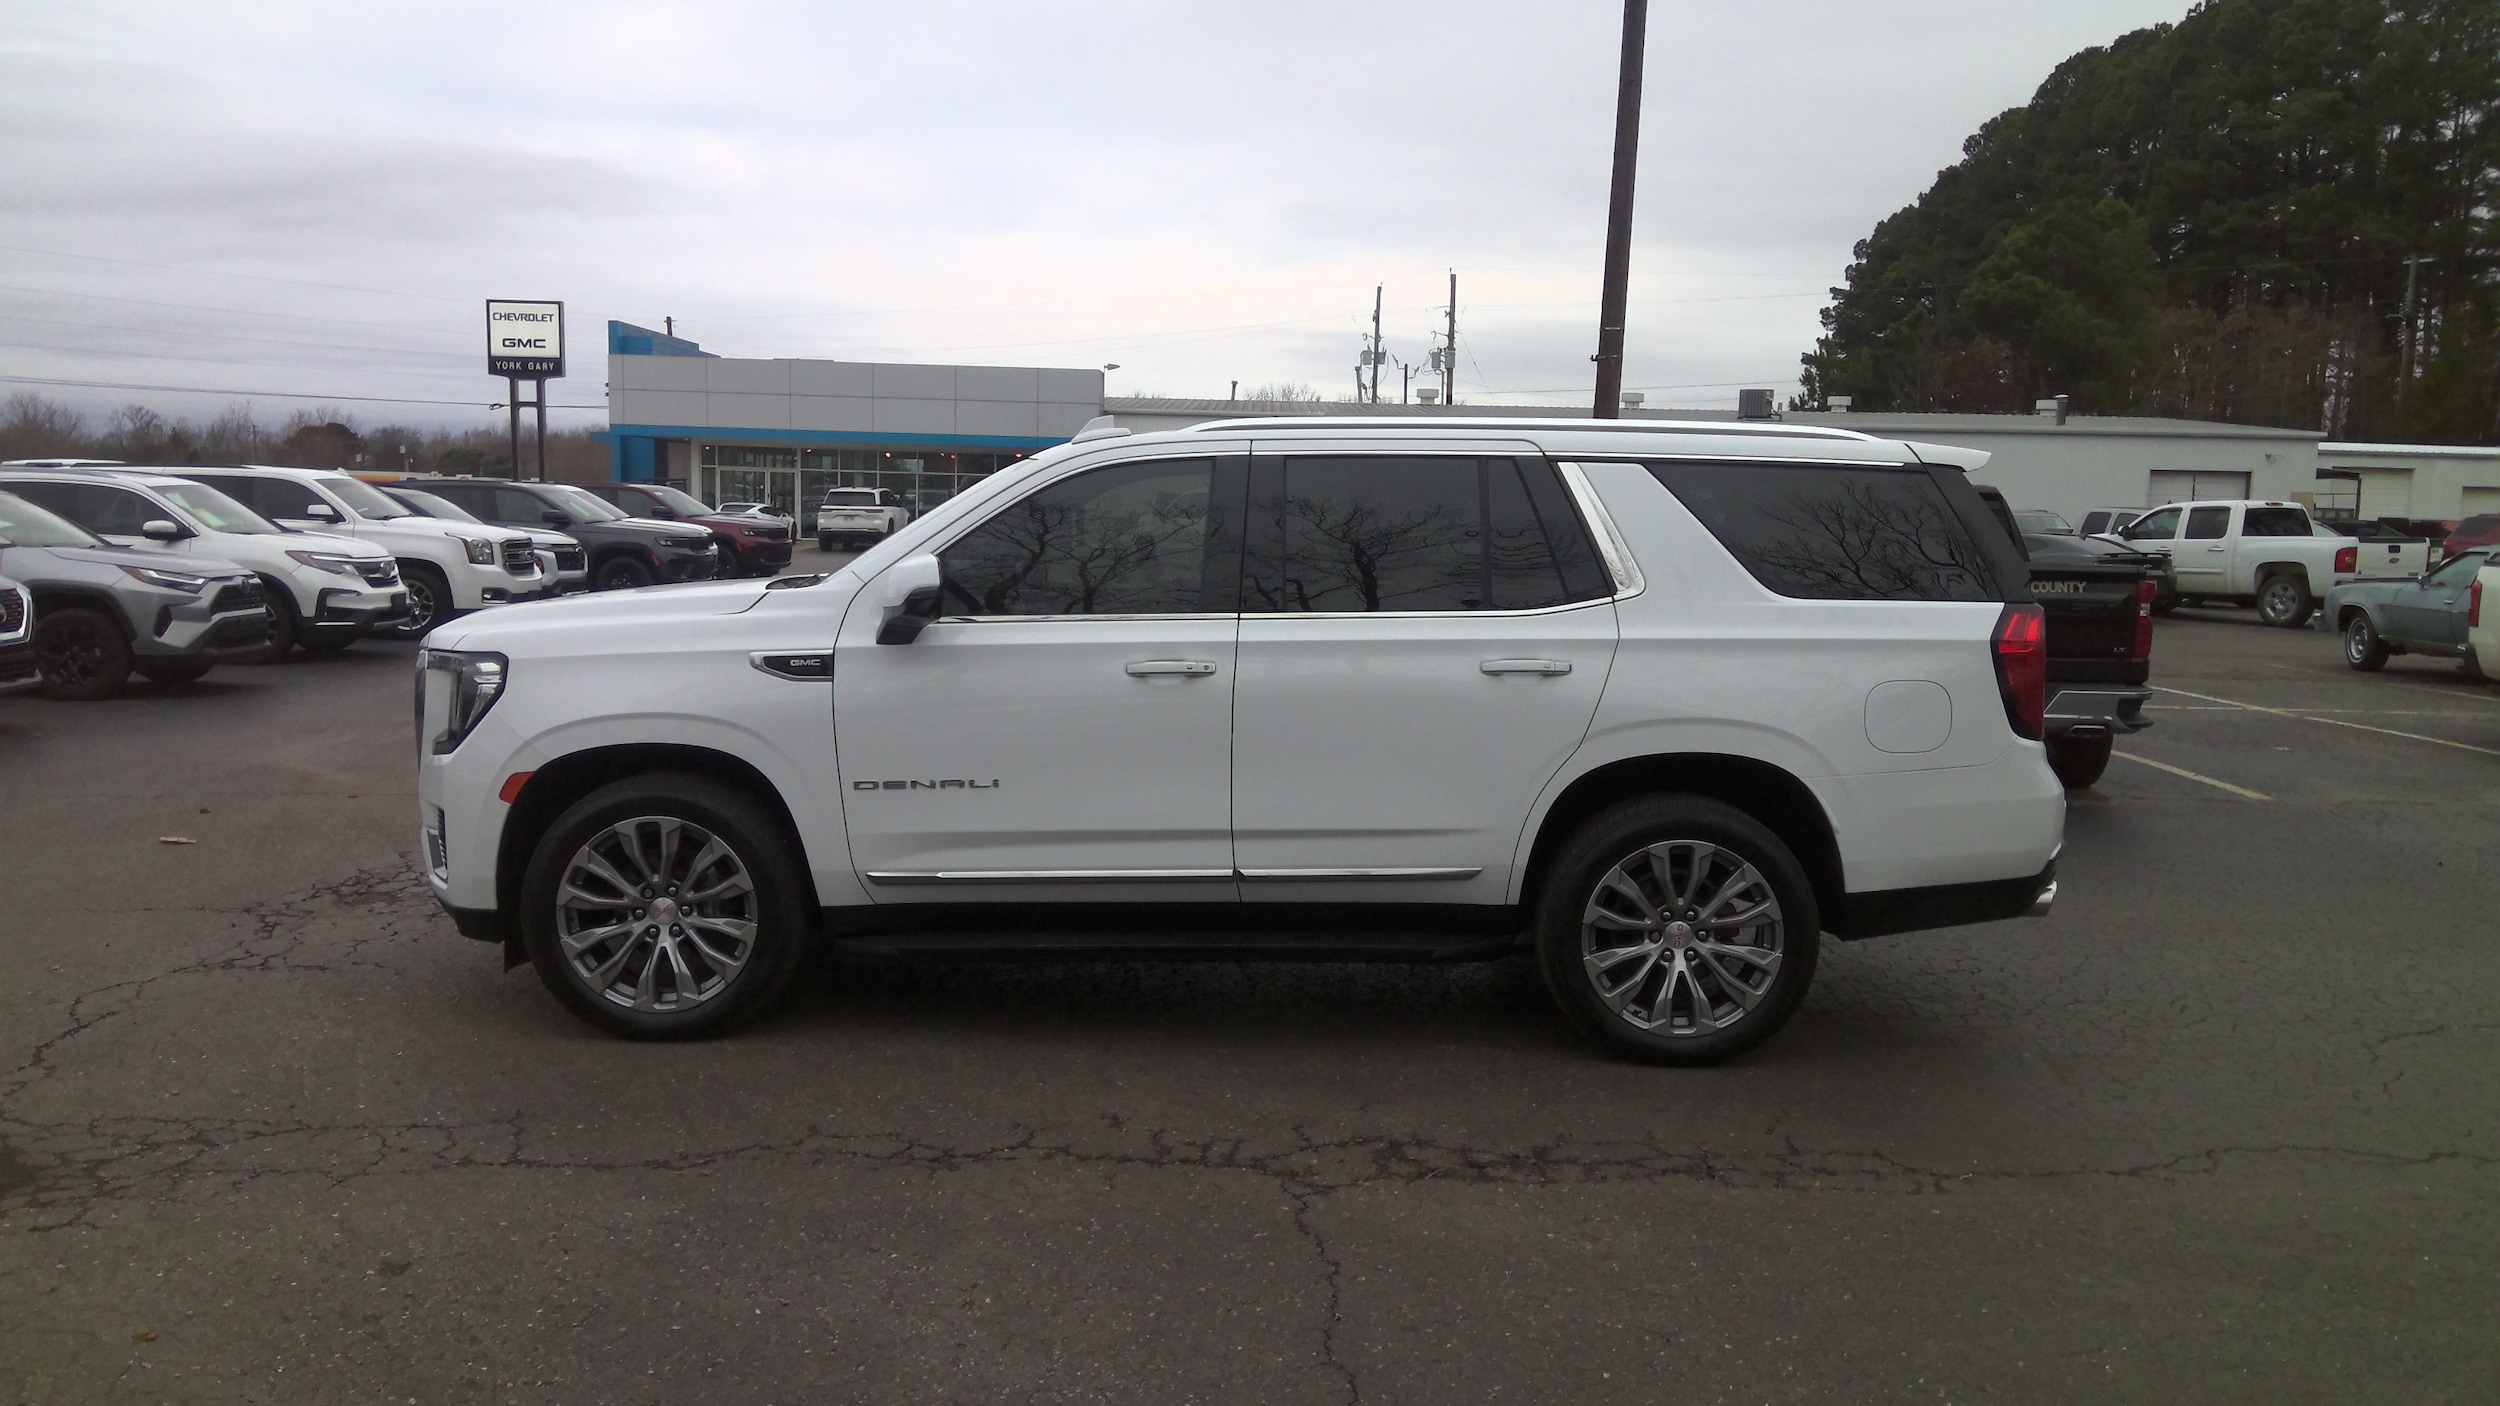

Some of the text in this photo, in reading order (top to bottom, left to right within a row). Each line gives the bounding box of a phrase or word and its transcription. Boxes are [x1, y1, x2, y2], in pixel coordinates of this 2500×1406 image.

[492, 312, 554, 322] CHEVROLET
[502, 338, 546, 348] GMC
[496, 361, 554, 371] YORK GARY
[2030, 581, 2087, 593] COUNTY
[789, 658, 821, 666] GMC
[853, 779, 999, 790] DENALI
